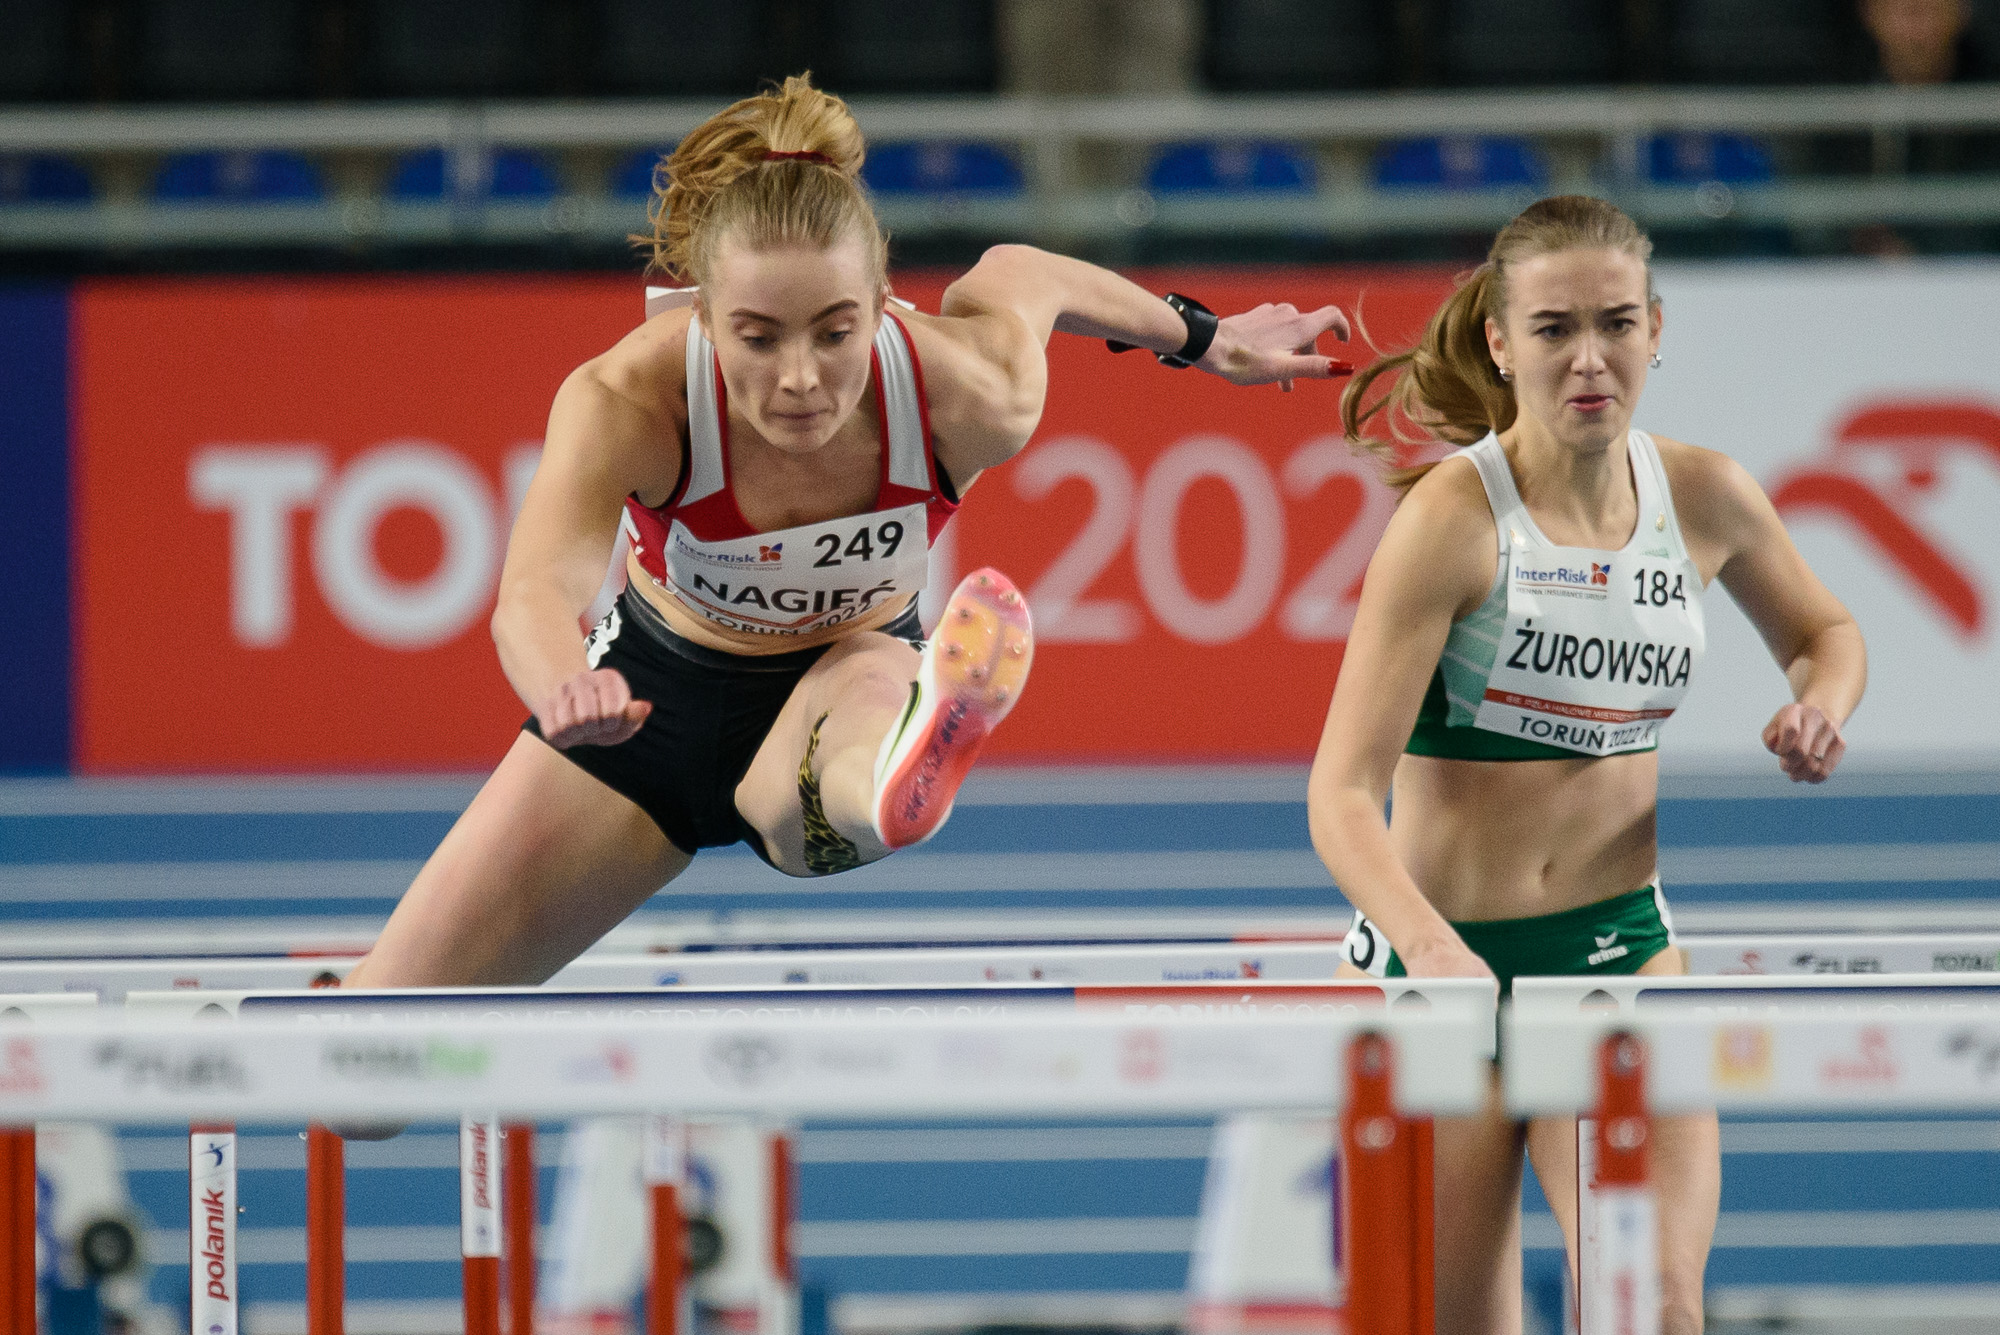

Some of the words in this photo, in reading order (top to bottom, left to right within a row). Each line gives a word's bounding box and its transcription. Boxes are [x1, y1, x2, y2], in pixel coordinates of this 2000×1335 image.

[188, 438, 545, 650] TO
[1012, 434, 1475, 645] 202
[675, 533, 756, 563] InterRisk
[813, 520, 904, 568] 249
[693, 573, 896, 614] NAGIEĆ
[1515, 565, 1588, 584] InterRisk
[1634, 568, 1686, 610] 184
[1506, 618, 1691, 687] ŻUROWSKA
[1519, 715, 1606, 750] TORUŃ
[1607, 726, 1642, 748] 2022
[201, 1187, 230, 1302] polanik
